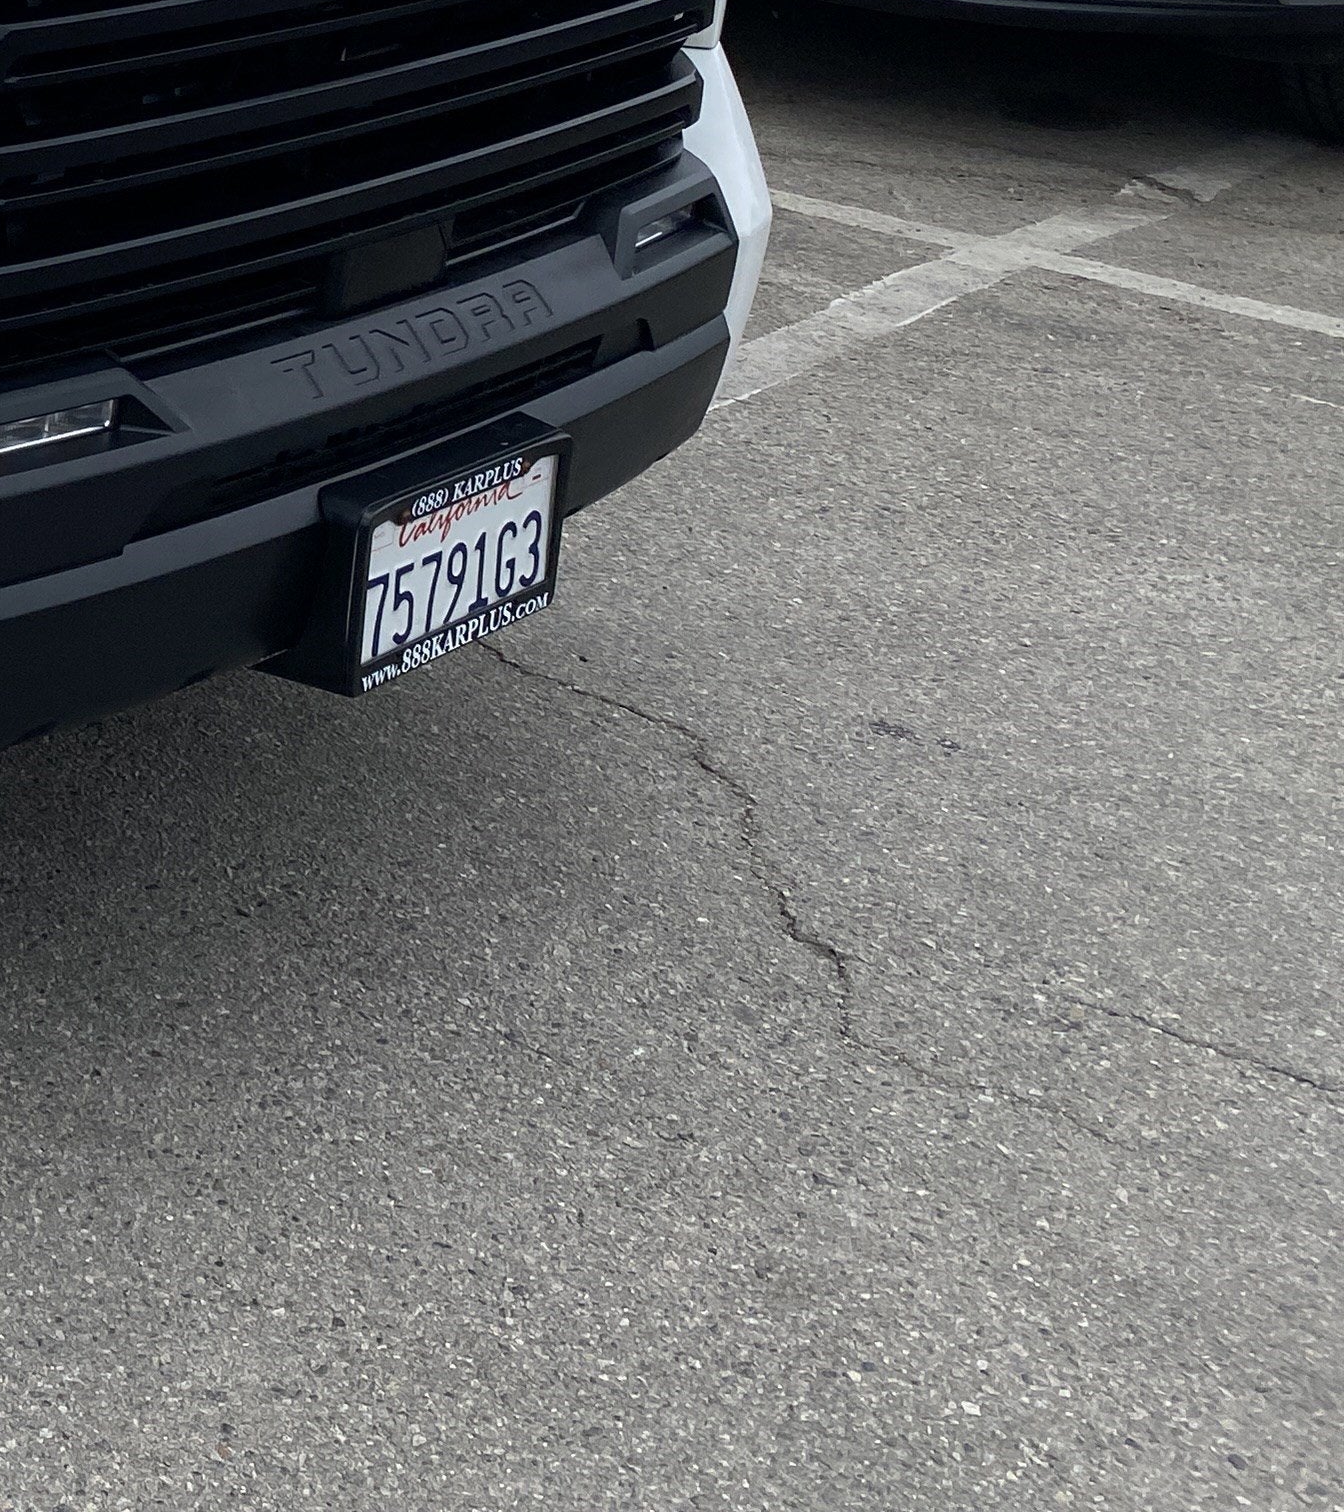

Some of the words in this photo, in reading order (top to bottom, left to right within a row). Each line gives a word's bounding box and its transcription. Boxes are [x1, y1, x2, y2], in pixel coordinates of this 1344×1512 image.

[270, 279, 553, 400] TUNDRA
[398, 481, 523, 548] California
[411, 488, 449, 517] (888)
[452, 457, 523, 502] KARPLUS
[366, 509, 543, 657] 75791G3
